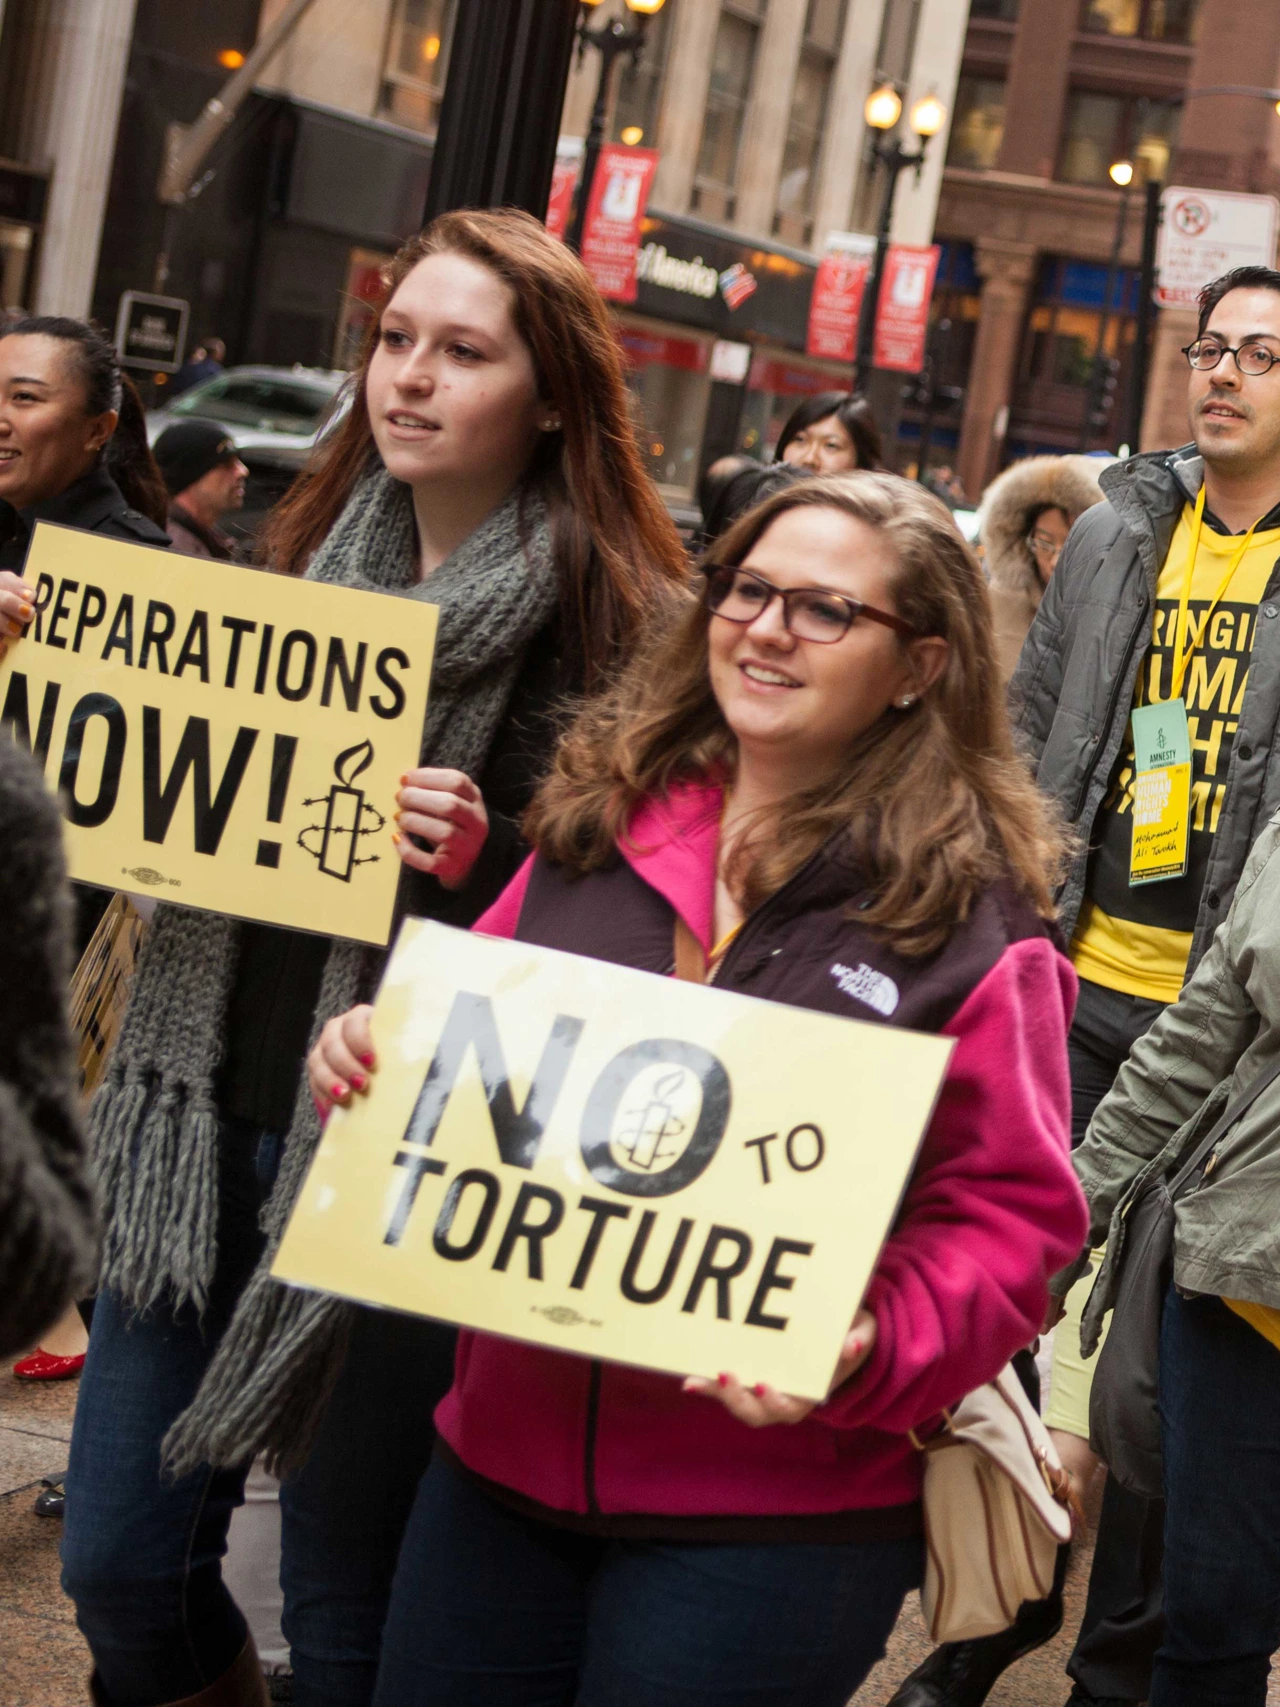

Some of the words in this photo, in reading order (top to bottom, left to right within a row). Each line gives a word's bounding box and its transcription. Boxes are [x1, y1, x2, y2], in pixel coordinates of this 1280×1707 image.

[1151, 608, 1258, 652] RINGI
[21, 571, 411, 720] REPARATIONS
[0, 670, 300, 869] NOW!
[1149, 749, 1177, 763] AMNESTY
[1136, 779, 1171, 799] HUMAN
[1134, 808, 1162, 827] HOME
[830, 962, 876, 992] NORTH
[857, 962, 884, 983] THE
[837, 978, 876, 1003] FACE
[401, 989, 734, 1198] NO
[743, 1121, 826, 1185] TO
[382, 1150, 815, 1333] TORTURE
